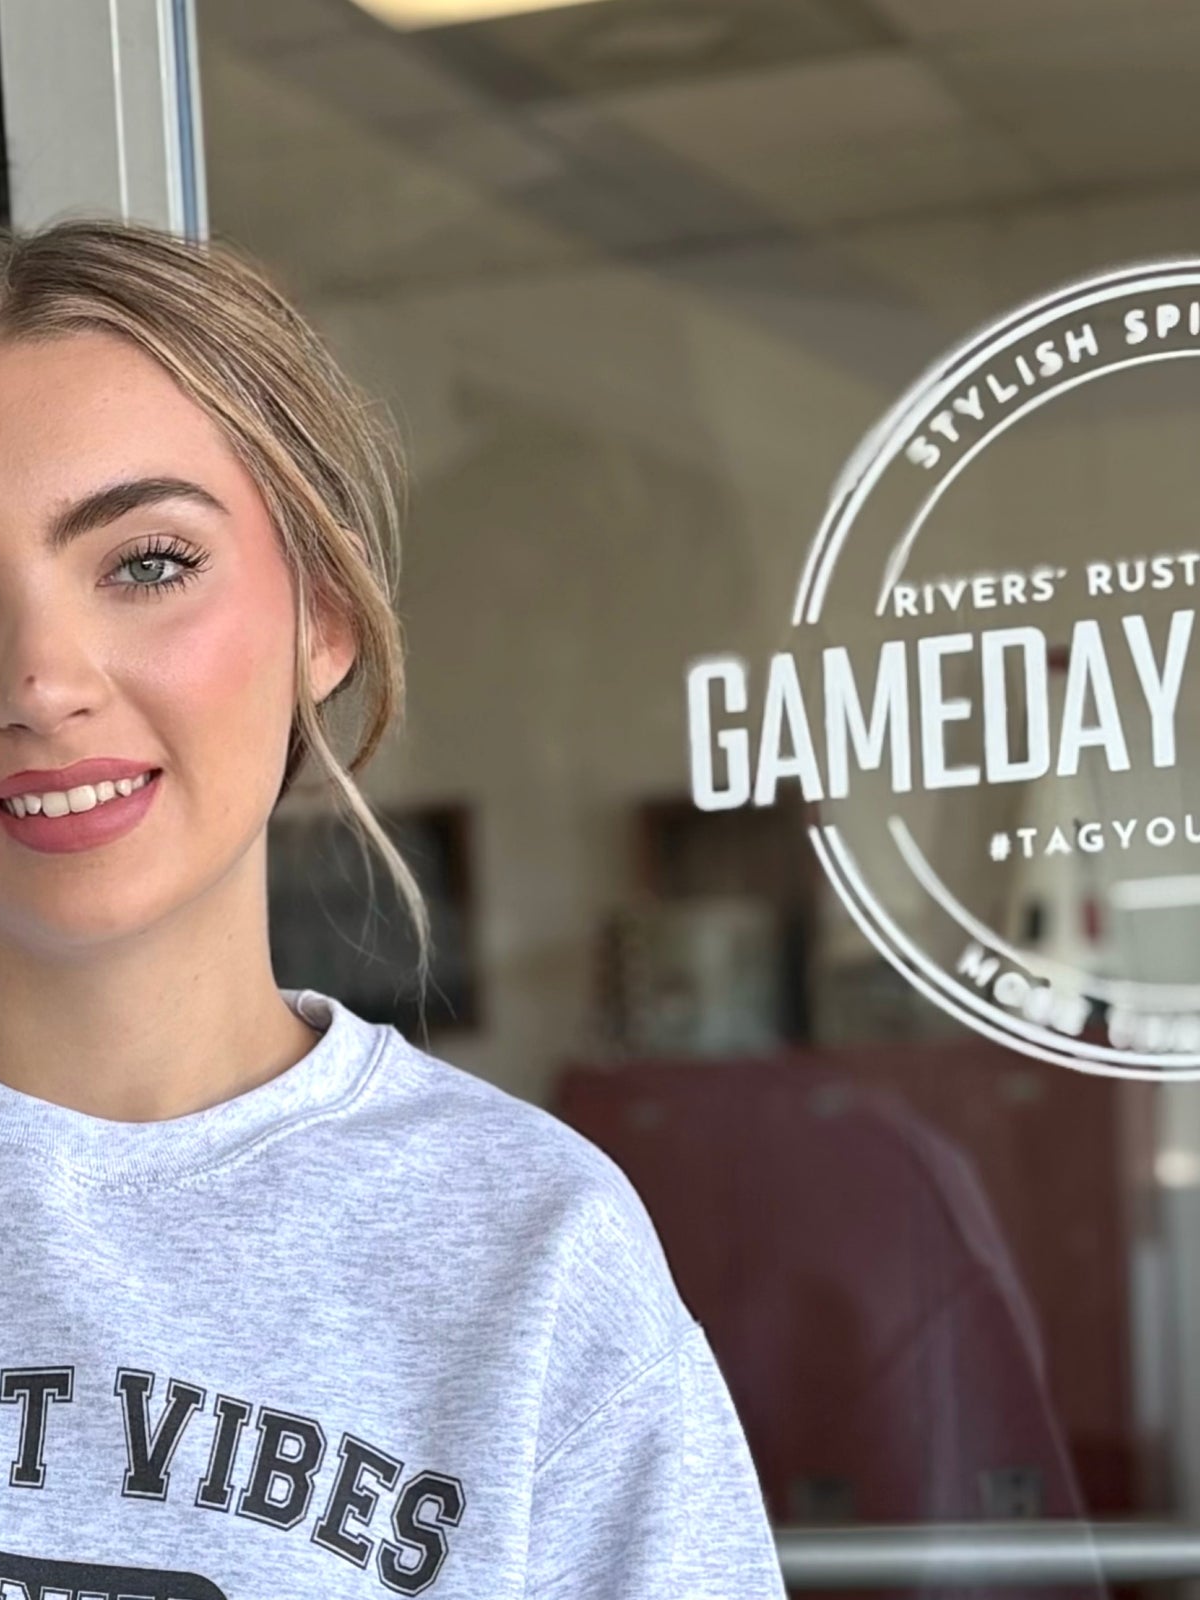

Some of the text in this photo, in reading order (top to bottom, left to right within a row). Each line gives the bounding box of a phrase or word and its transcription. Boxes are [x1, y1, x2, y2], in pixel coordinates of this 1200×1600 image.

[906, 324, 1099, 469] STYLISH
[1086, 553, 1200, 597] RUST
[687, 610, 1195, 811] GAMEDAY
[115, 1367, 465, 1598] VIBES
